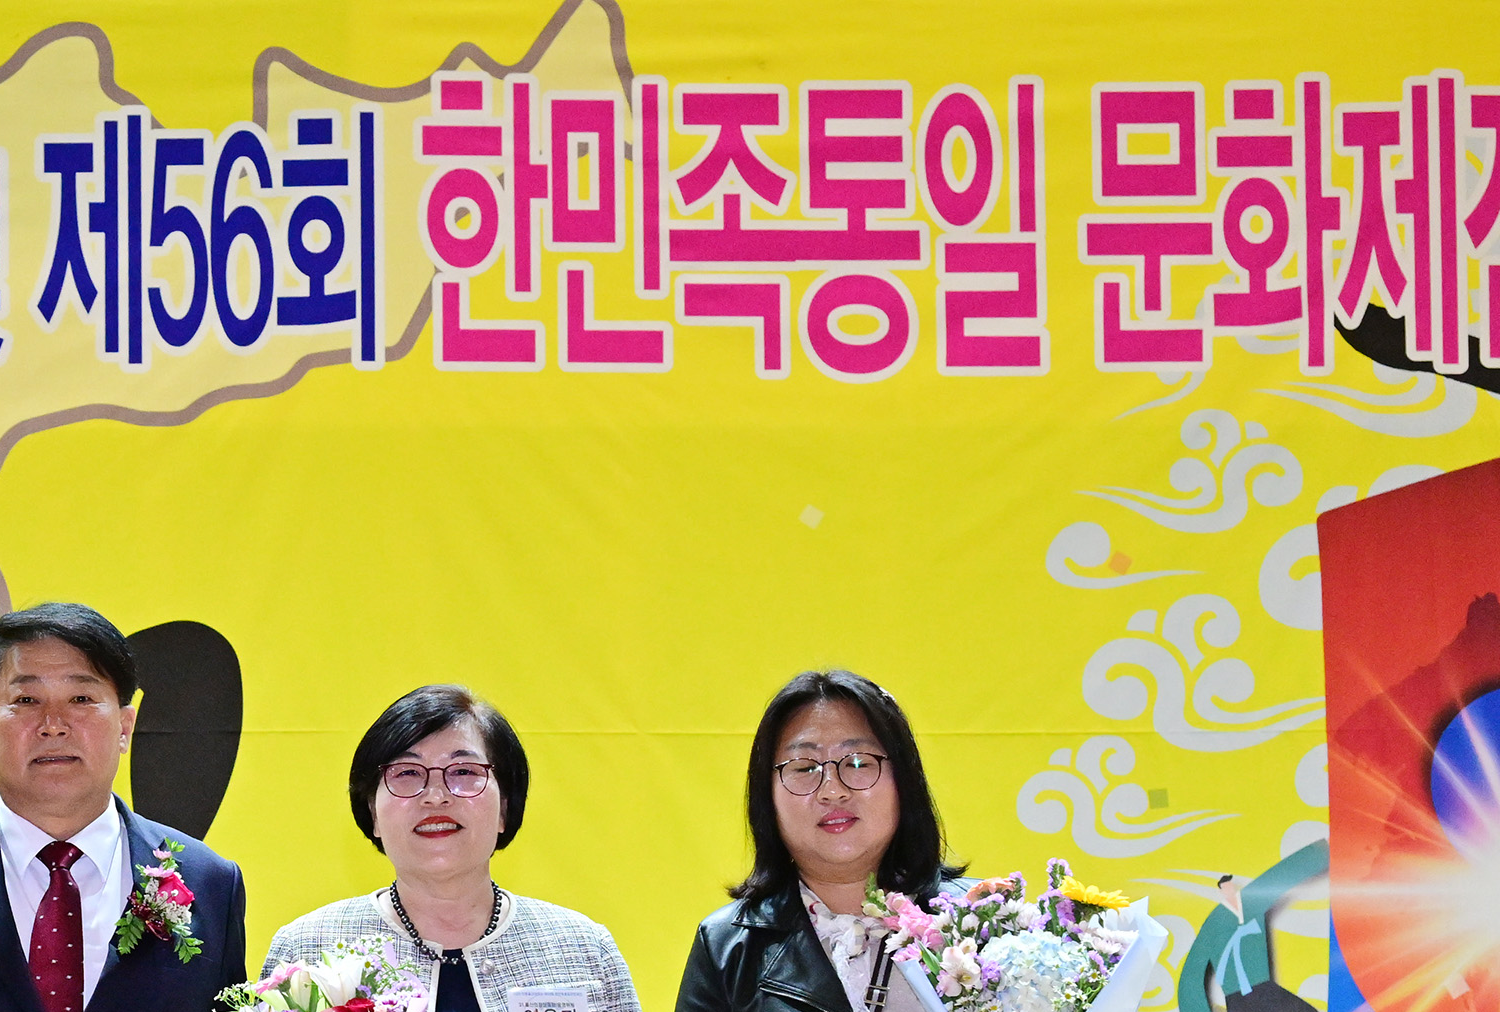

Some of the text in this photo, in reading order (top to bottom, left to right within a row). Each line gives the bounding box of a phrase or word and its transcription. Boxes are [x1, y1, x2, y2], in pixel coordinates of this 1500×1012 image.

[37, 112, 376, 365] 제56회
[422, 80, 1043, 375] 한민족통일
[1086, 77, 1500, 368] 문화제
